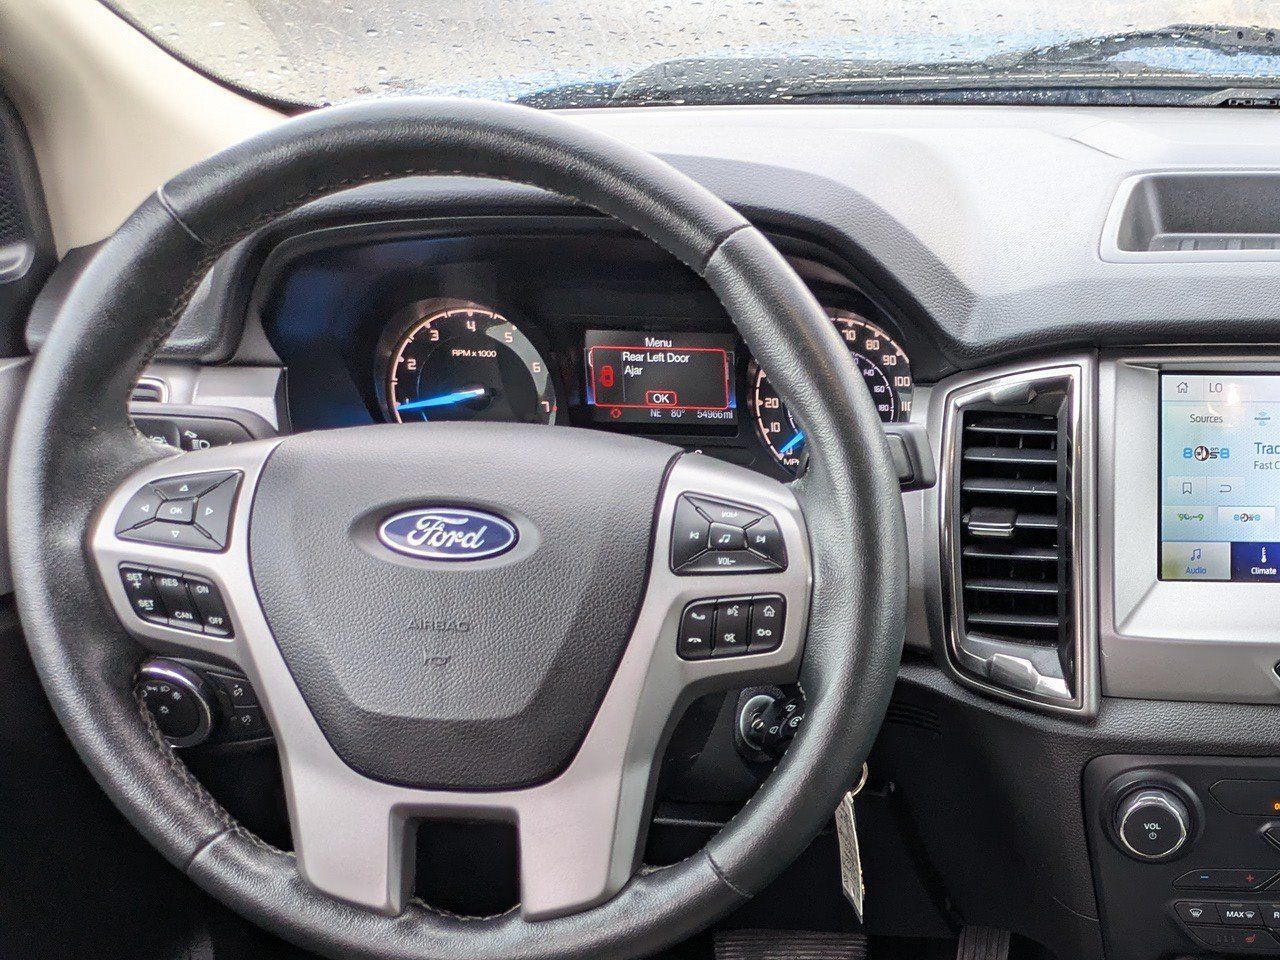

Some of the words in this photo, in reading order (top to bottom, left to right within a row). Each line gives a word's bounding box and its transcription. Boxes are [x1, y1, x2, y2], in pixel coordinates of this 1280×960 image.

[466, 321, 476, 332] 4
[430, 330, 439, 341] 3
[504, 332, 513, 343] 5
[842, 330, 856, 341] 70
[645, 337, 672, 347] Menu
[865, 339, 880, 350] 80
[478, 350, 497, 358] 1000
[622, 352, 644, 362] Rear
[647, 352, 665, 362] Left
[667, 353, 690, 363] Door
[408, 359, 417, 370] 2
[882, 355, 897, 366] 90
[532, 362, 541, 373] 6
[624, 365, 643, 377] Ajar
[894, 376, 910, 387] 100
[1209, 383, 1223, 393] LO
[653, 394, 670, 403] OK
[765, 398, 779, 408] 20
[541, 401, 550, 412] 7
[1189, 414, 1224, 423] Sources
[770, 422, 781, 433] 10
[1254, 461, 1273, 470] Fast
[407, 515, 488, 549] Ford
[1186, 566, 1207, 574] Audio
[1251, 567, 1277, 575] Climate
[161, 579, 179, 587] RES
[407, 620, 470, 632] AIRBAG
